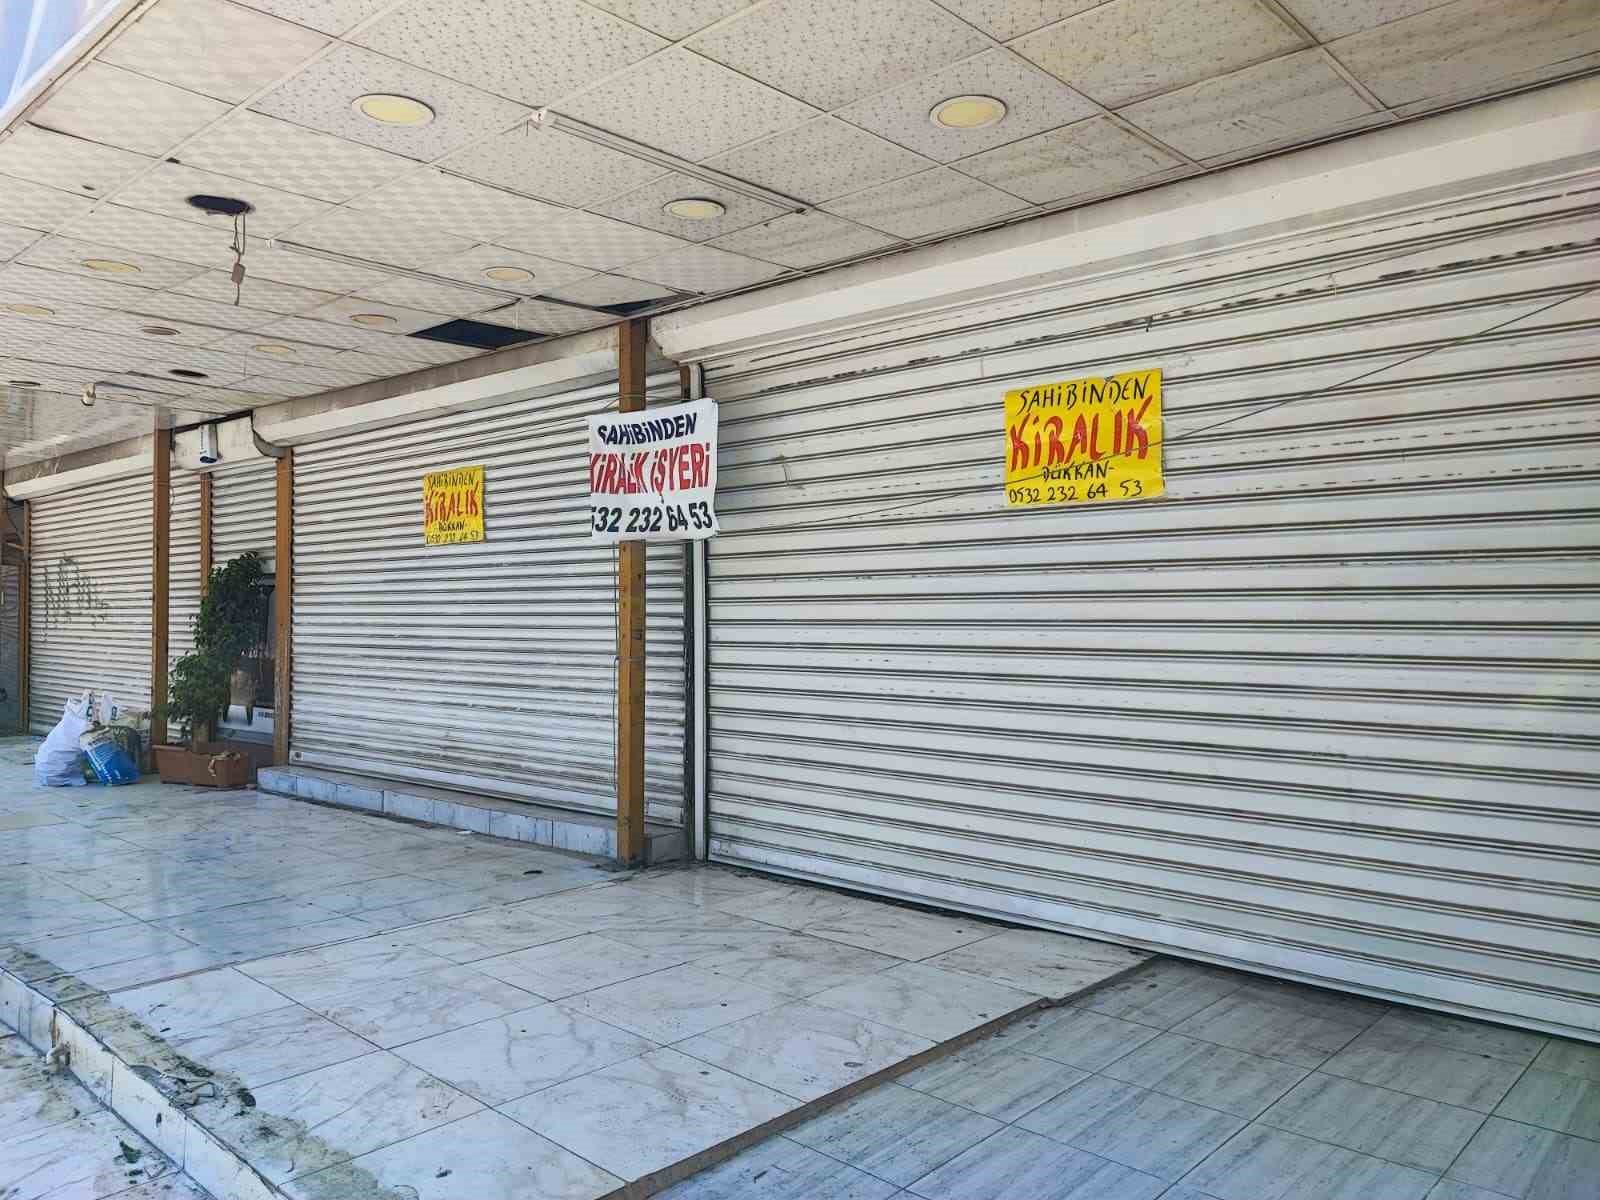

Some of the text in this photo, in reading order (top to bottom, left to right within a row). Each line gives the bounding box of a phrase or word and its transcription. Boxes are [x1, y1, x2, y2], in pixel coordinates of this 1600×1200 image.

[1009, 479, 1143, 504] 0532 232 64 53
[625, 505, 663, 533] 232
[666, 504, 689, 532] 64
[688, 501, 713, 530] 53
